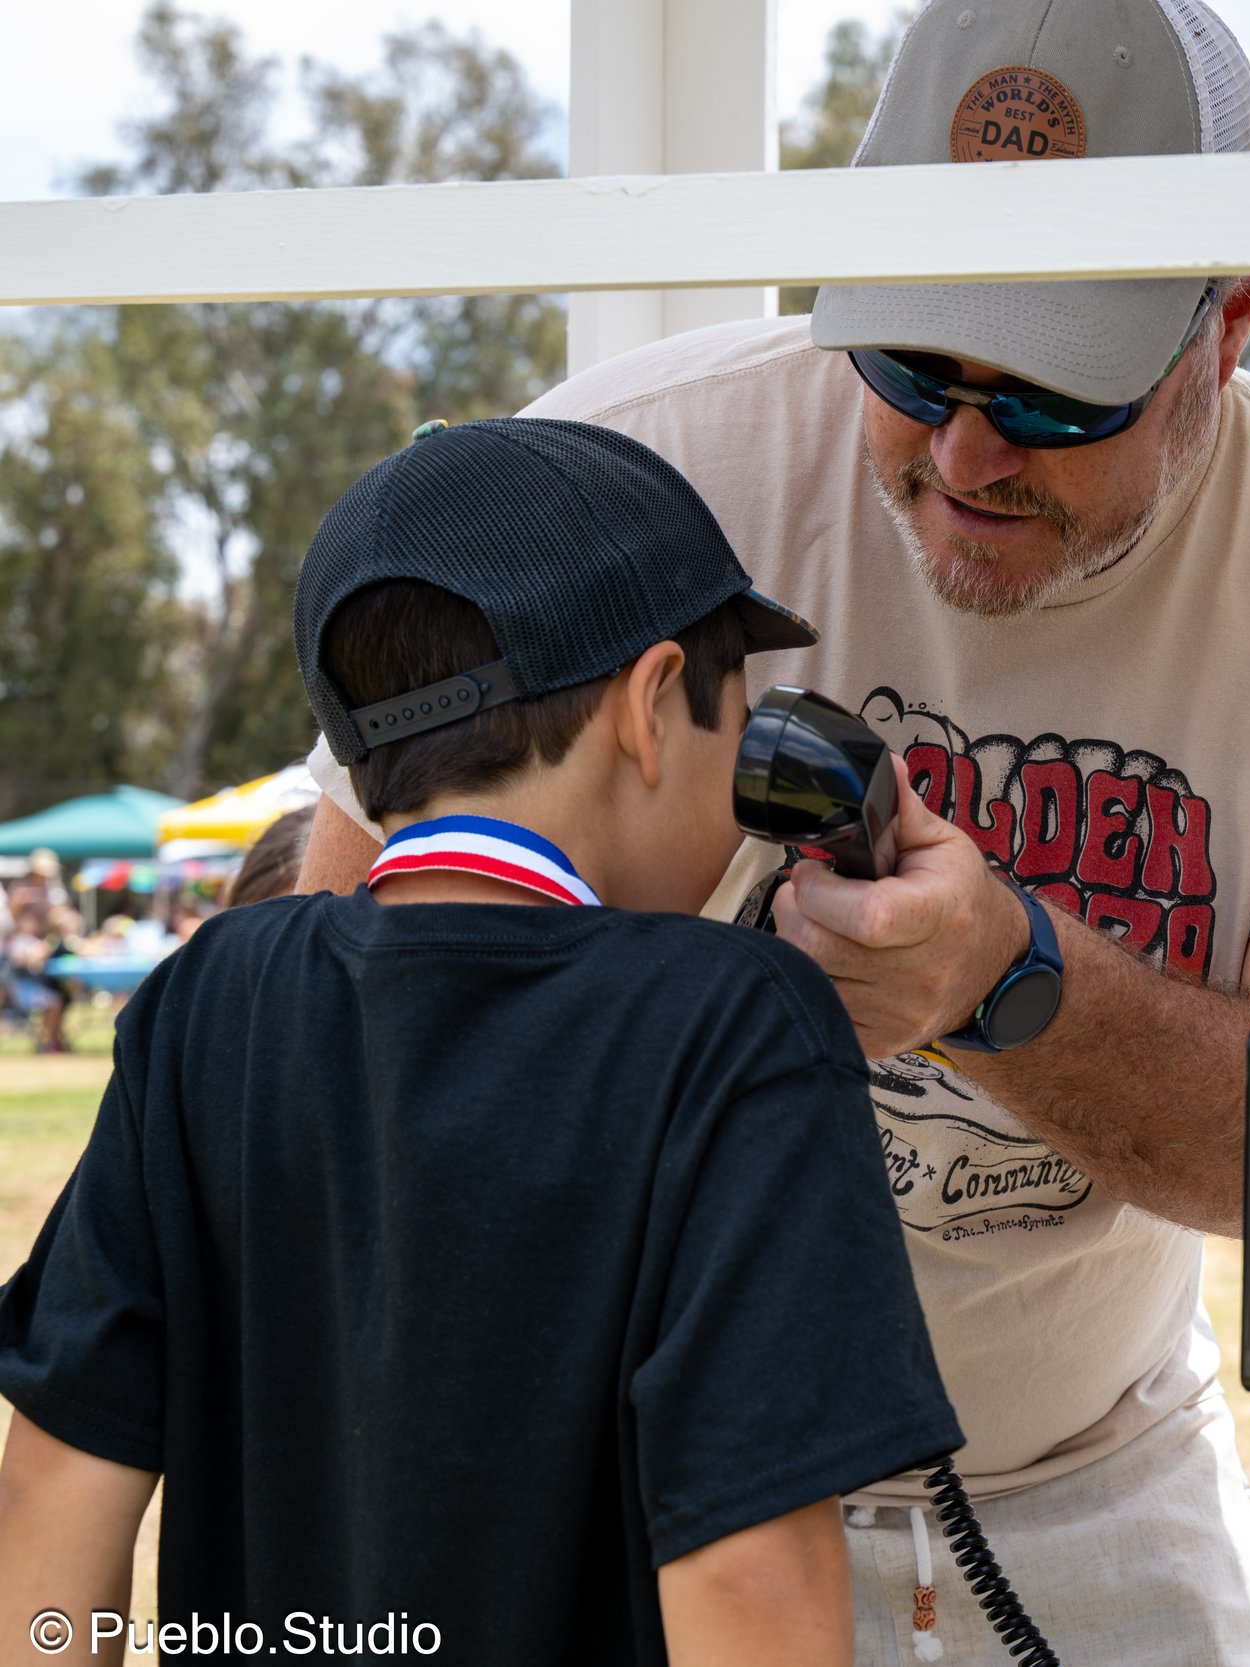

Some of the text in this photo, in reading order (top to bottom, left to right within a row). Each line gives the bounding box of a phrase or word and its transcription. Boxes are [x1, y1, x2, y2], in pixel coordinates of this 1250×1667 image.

[966, 75, 1076, 135] THE MAN THE MYTH
[981, 88, 1060, 128] WORLD'S
[1005, 107, 1035, 122] BEST
[981, 120, 1049, 156] DAD
